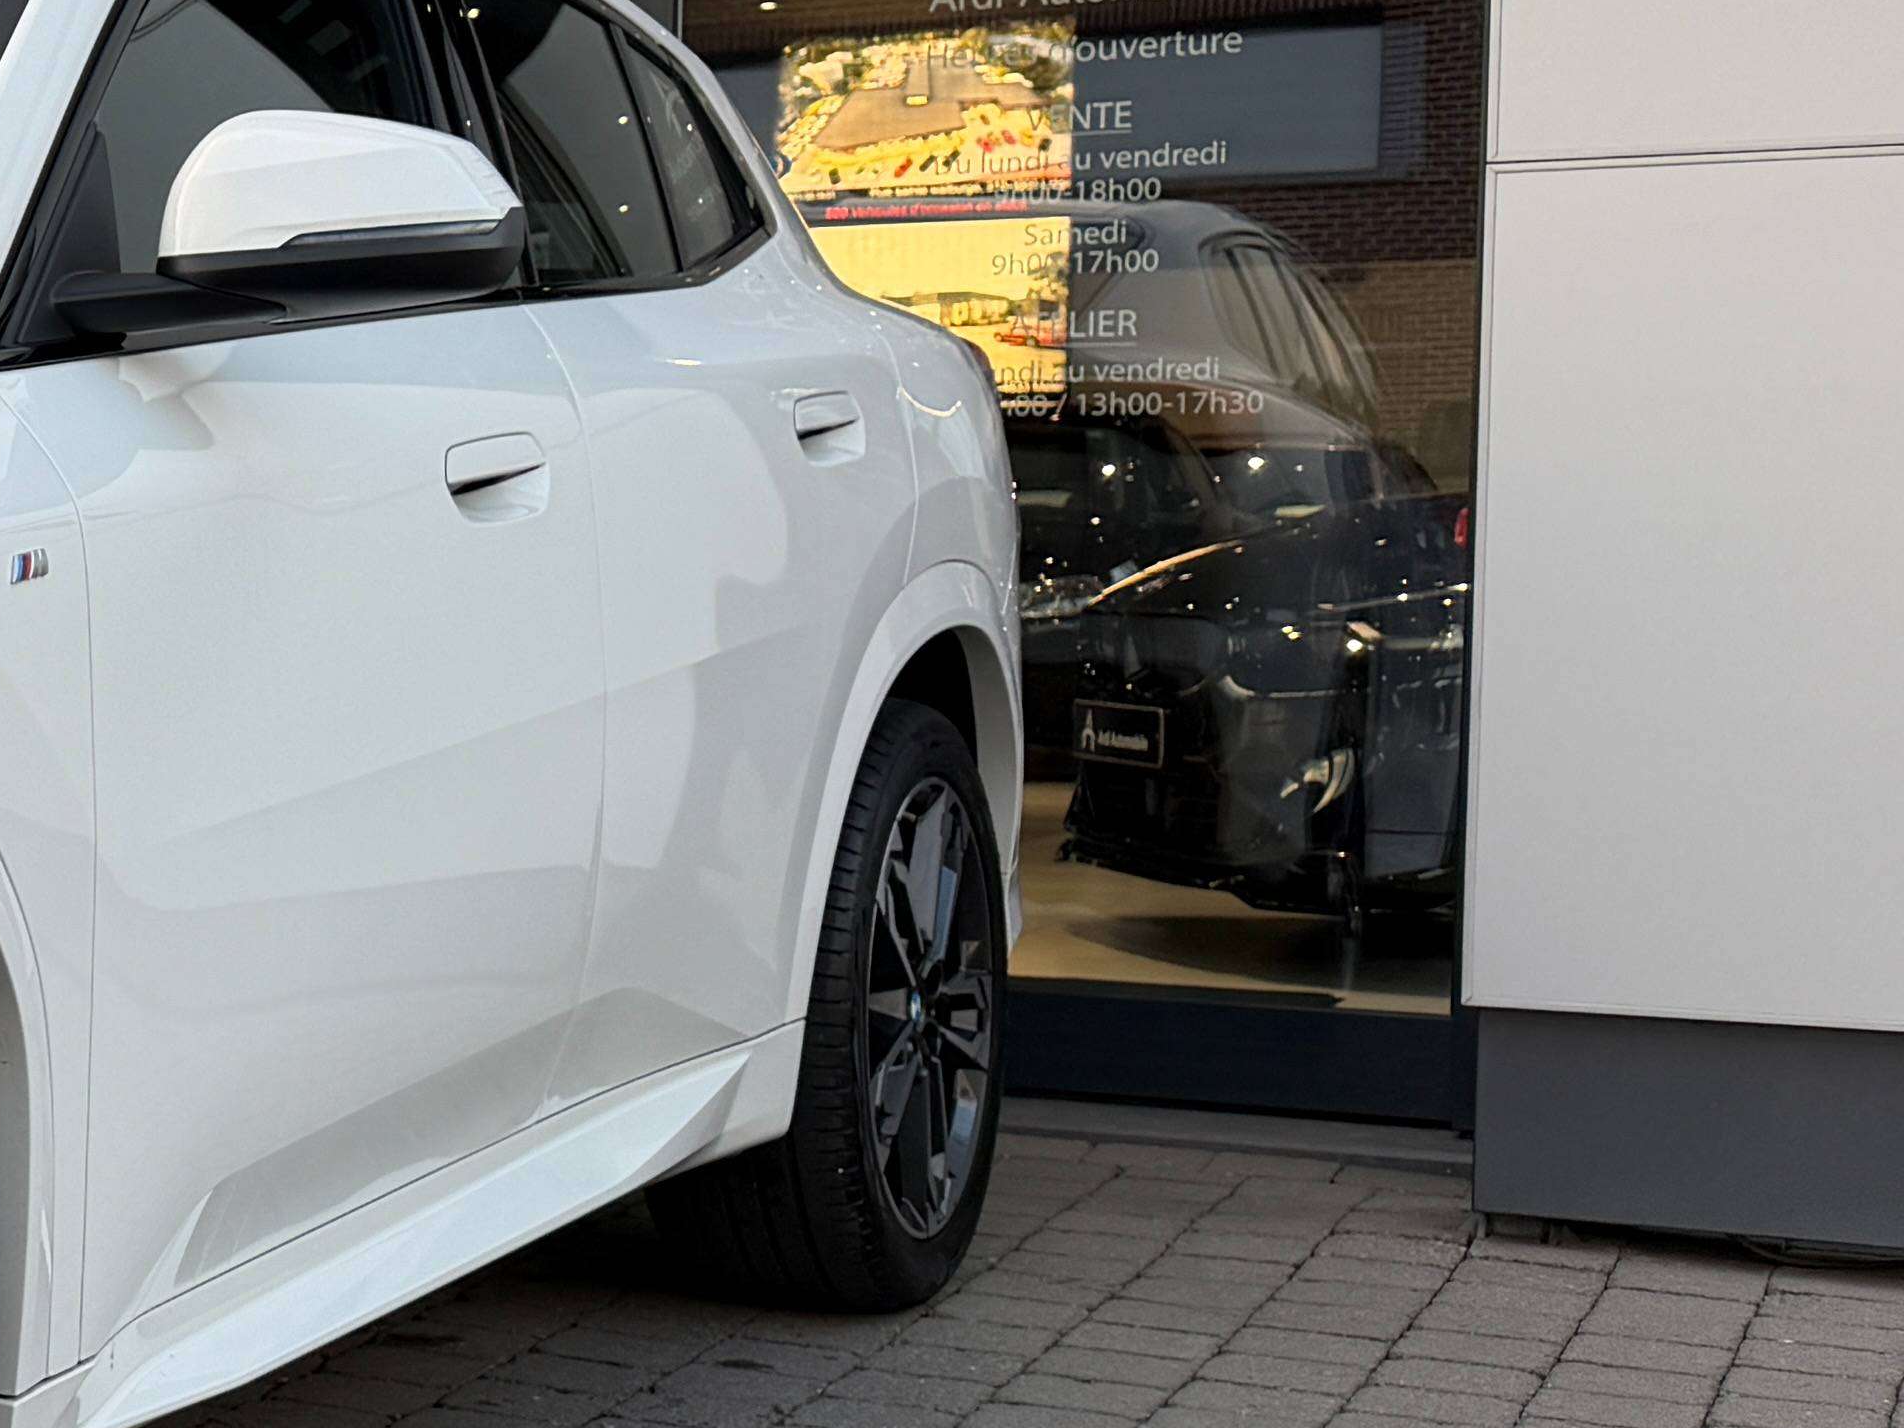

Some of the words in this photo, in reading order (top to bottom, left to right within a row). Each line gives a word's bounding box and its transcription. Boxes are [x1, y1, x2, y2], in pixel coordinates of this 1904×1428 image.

[1027, 99, 1133, 131] VENTE
[1058, 149, 1091, 171] u
[1100, 140, 1227, 169] vendredi
[1024, 220, 1127, 247] Samedi
[1093, 357, 1220, 383] vendredi
[1076, 389, 1264, 418] 13h00-17h30
